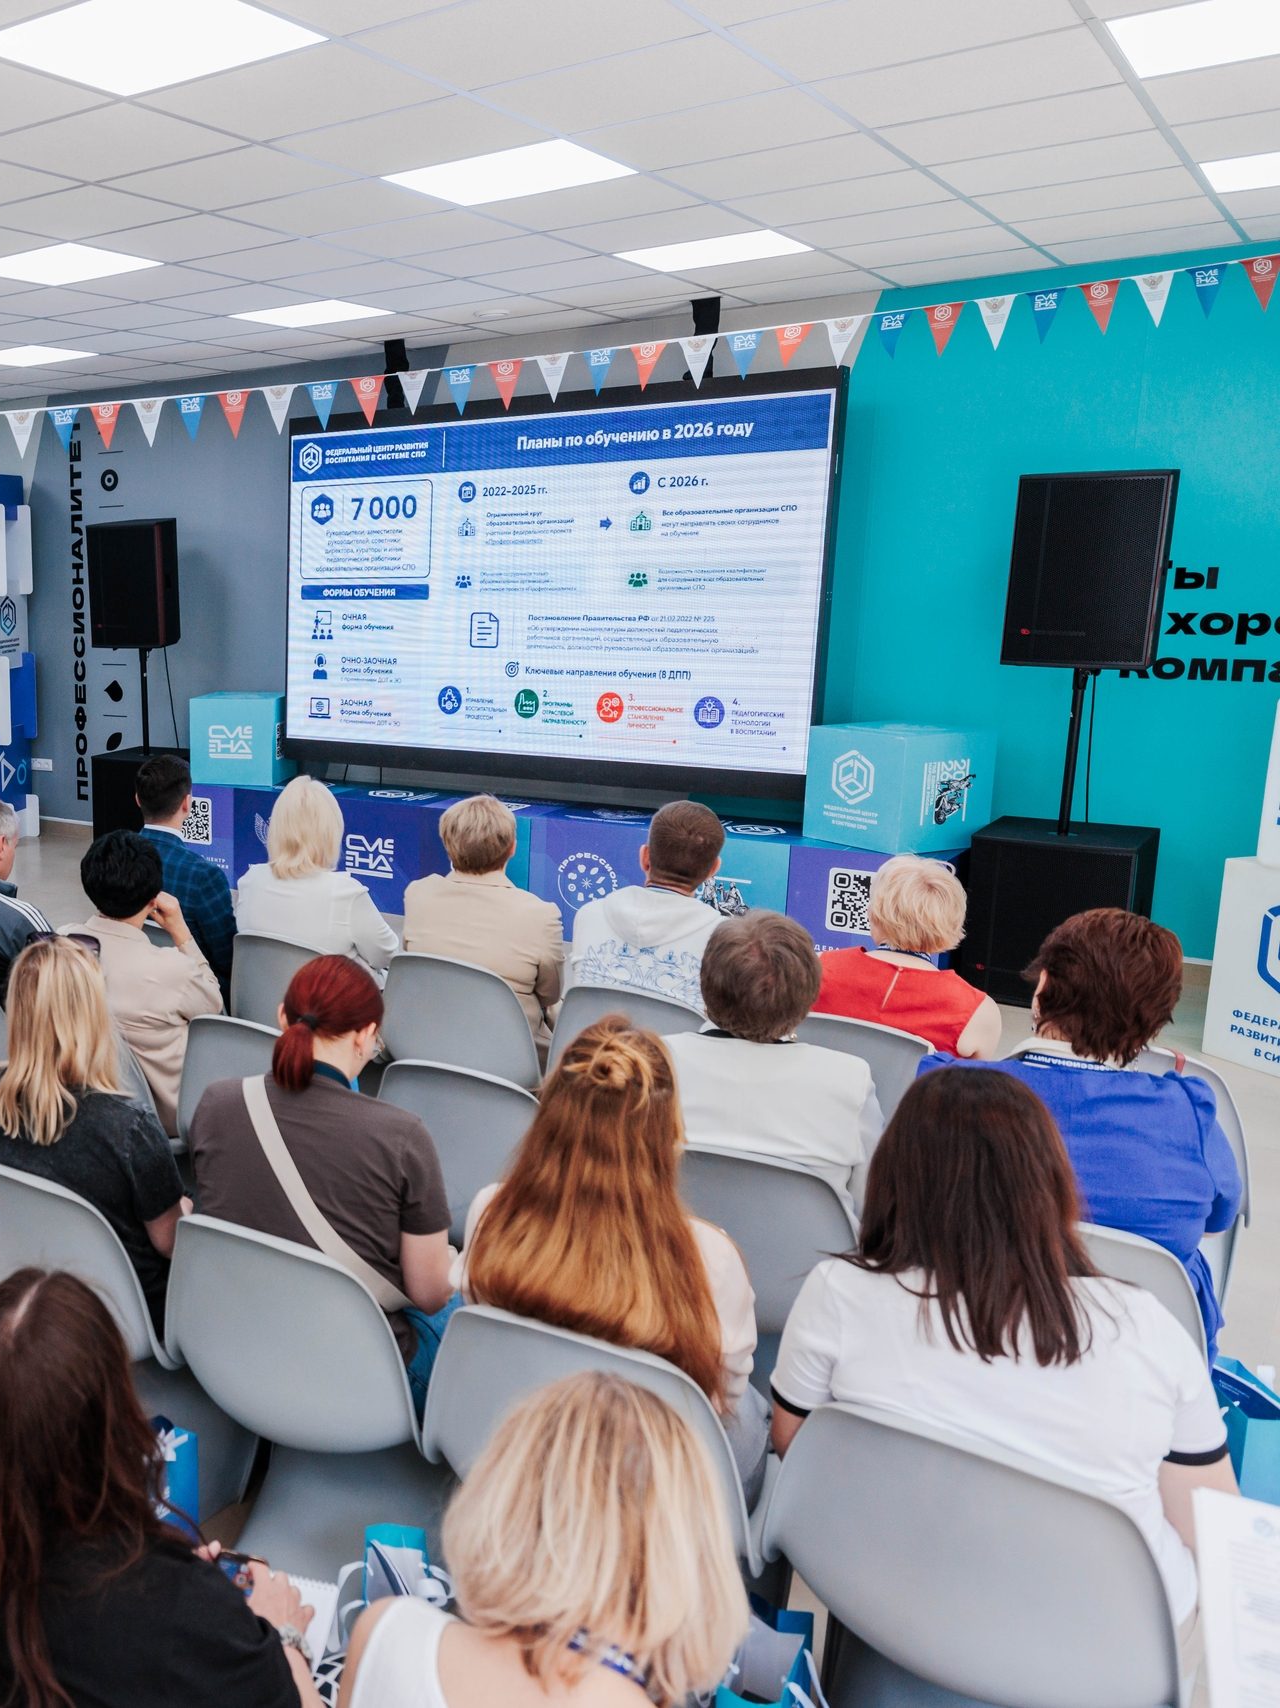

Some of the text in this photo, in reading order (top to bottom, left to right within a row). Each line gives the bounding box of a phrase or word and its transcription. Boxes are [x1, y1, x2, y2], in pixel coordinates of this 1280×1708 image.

[517, 422, 754, 450] Планы по обучению в 2026 году
[325, 441, 428, 456] ФЕДЕРАЛЬНЫЙ ЦЕНТР РАЗВИТИЯ
[325, 453, 370, 464] ВОСПИТАНИЯ
[377, 451, 409, 460] СИСТЕМЕ
[658, 475, 709, 488] С 2026 г.
[351, 495, 417, 521] 7 000
[674, 508, 733, 517] образовательные
[734, 506, 779, 514] организации
[1167, 560, 1219, 590] ы
[322, 588, 396, 597] ФОРМЫ ОБУЧЕНИЯ
[528, 614, 581, 622] Постановление
[341, 623, 394, 631] форма обучения
[341, 656, 398, 665] ОЧНО-ЗАОЧНАЯ
[341, 667, 393, 675] форма обучения
[525, 666, 565, 677] Ключевые
[565, 668, 617, 679] направления
[618, 669, 657, 679] обучения
[667, 670, 692, 681] ДПП)
[542, 690, 549, 698] 2.
[628, 693, 635, 702] 3.
[340, 699, 373, 707] ЗАОЧНАЯ
[732, 698, 741, 706] 4.
[340, 709, 392, 718] форма обучения
[627, 705, 684, 713] ПРОФЕССИОНАЛЬНОЕ
[731, 710, 785, 719] ПЕДАГОГИЧЕСКИЕ
[731, 719, 771, 727] ТЕХНОЛОГИИ
[735, 729, 777, 737] ВОСПИТАНИИ
[1254, 1047, 1262, 1057] В
